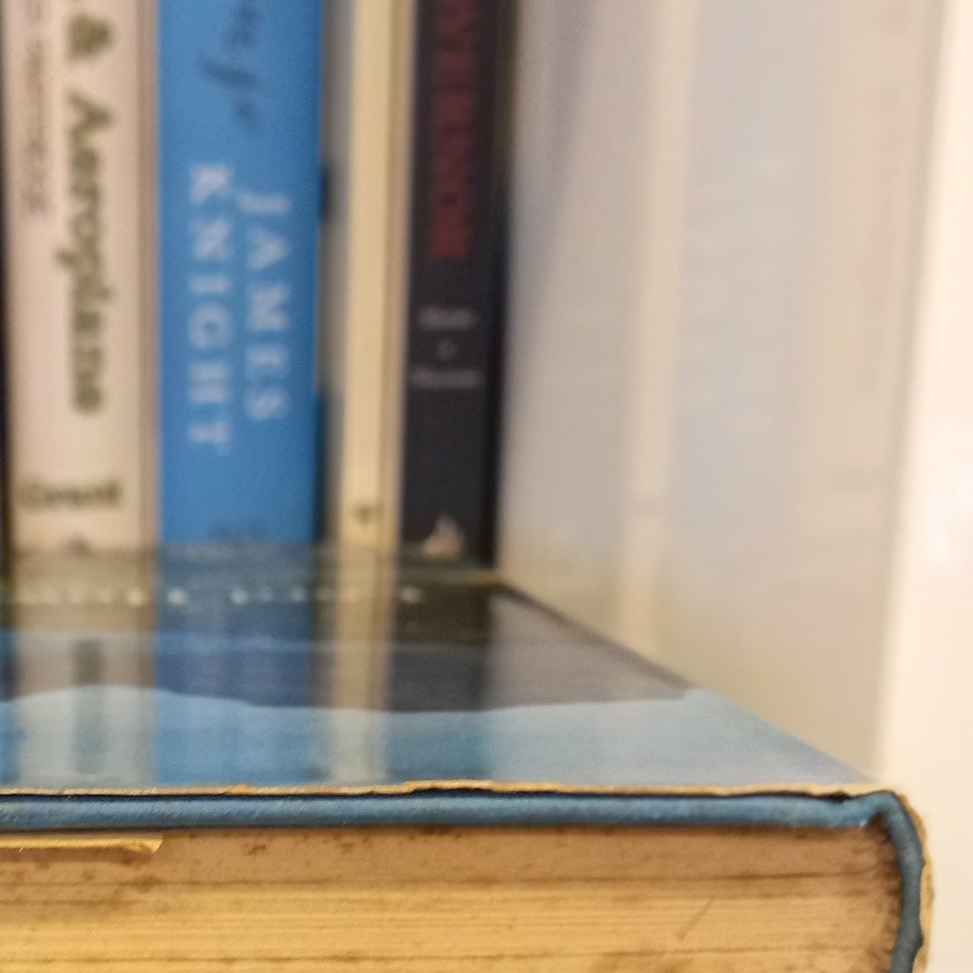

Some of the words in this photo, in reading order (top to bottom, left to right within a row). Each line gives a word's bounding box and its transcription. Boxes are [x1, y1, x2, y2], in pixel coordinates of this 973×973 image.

[68, 14, 112, 61] &
[433, 0, 479, 257] VERNOR
[55, 91, 113, 414] Aeroplane
[188, 162, 233, 450] KNIGHT
[239, 191, 290, 421] JAMES
